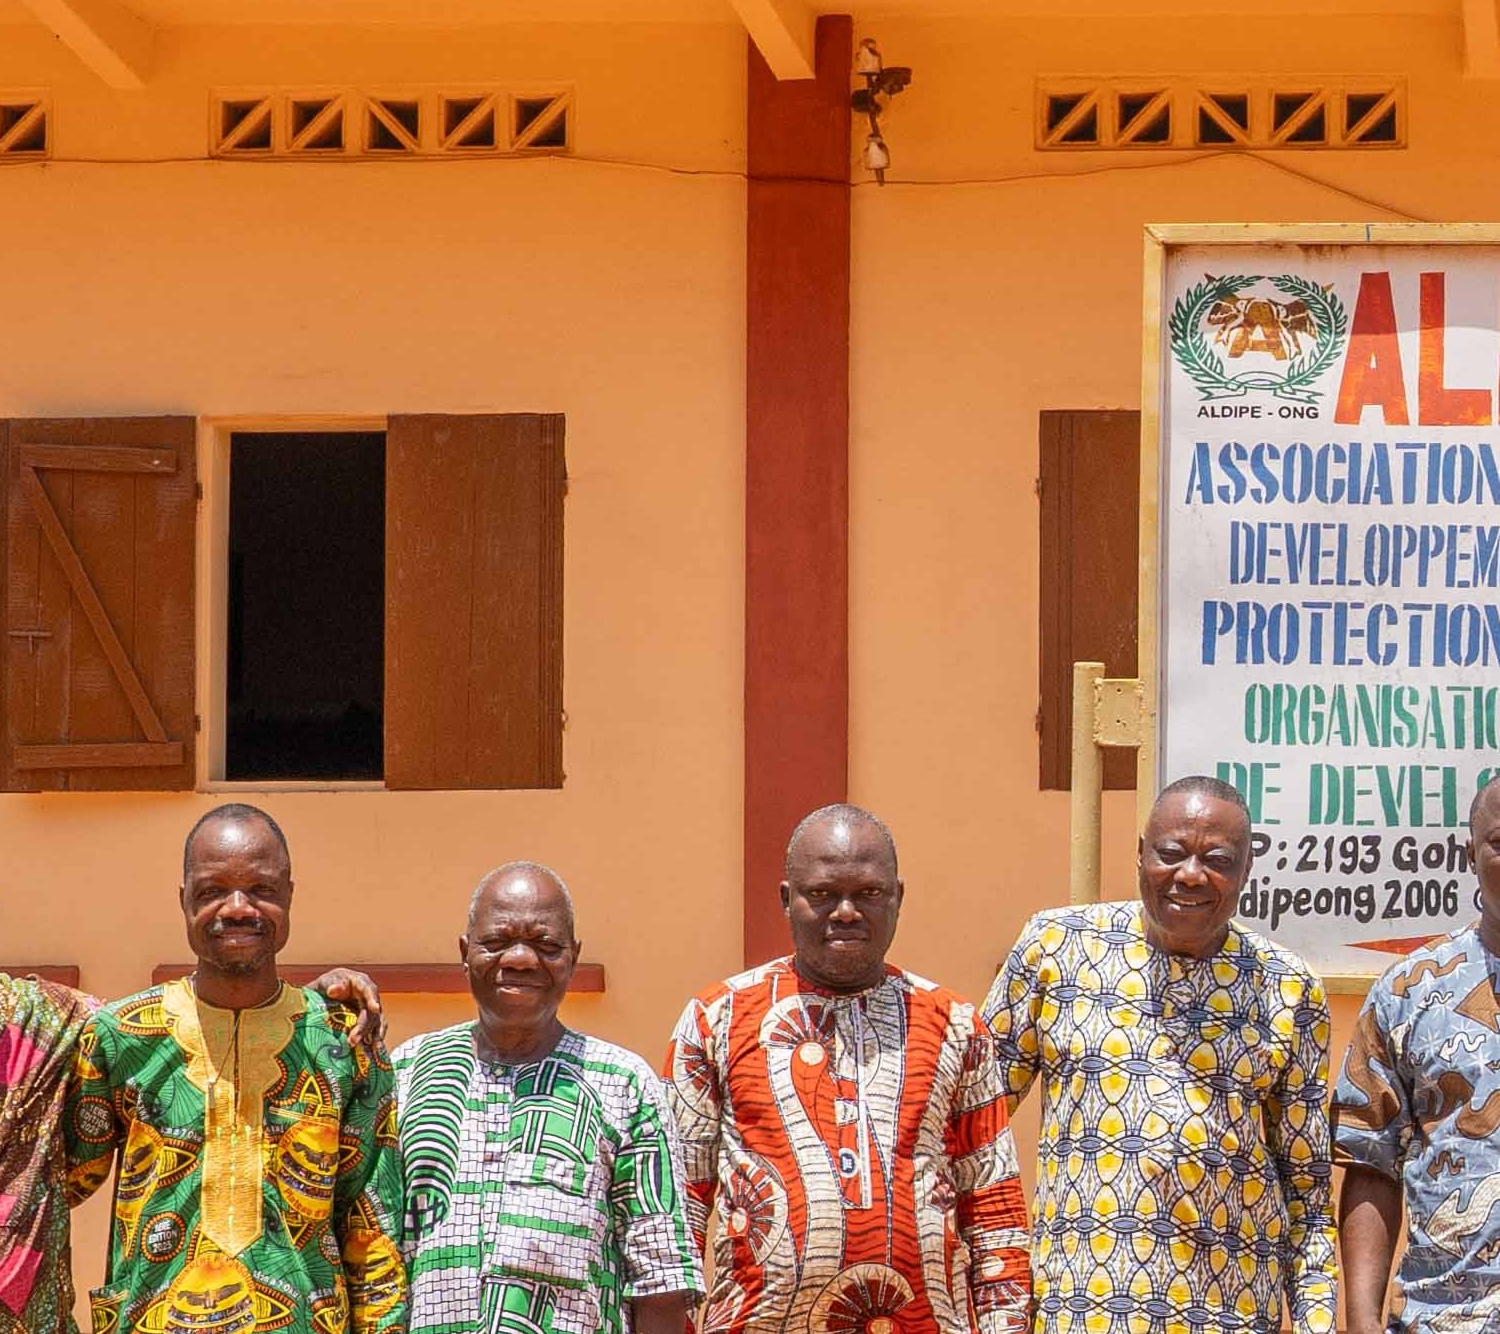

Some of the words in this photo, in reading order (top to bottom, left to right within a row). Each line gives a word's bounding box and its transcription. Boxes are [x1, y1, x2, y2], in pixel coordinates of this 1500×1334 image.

[1197, 405, 1263, 419] ALDIPE
[1278, 406, 1320, 420] ONG
[1295, 834, 1382, 875] 2193
